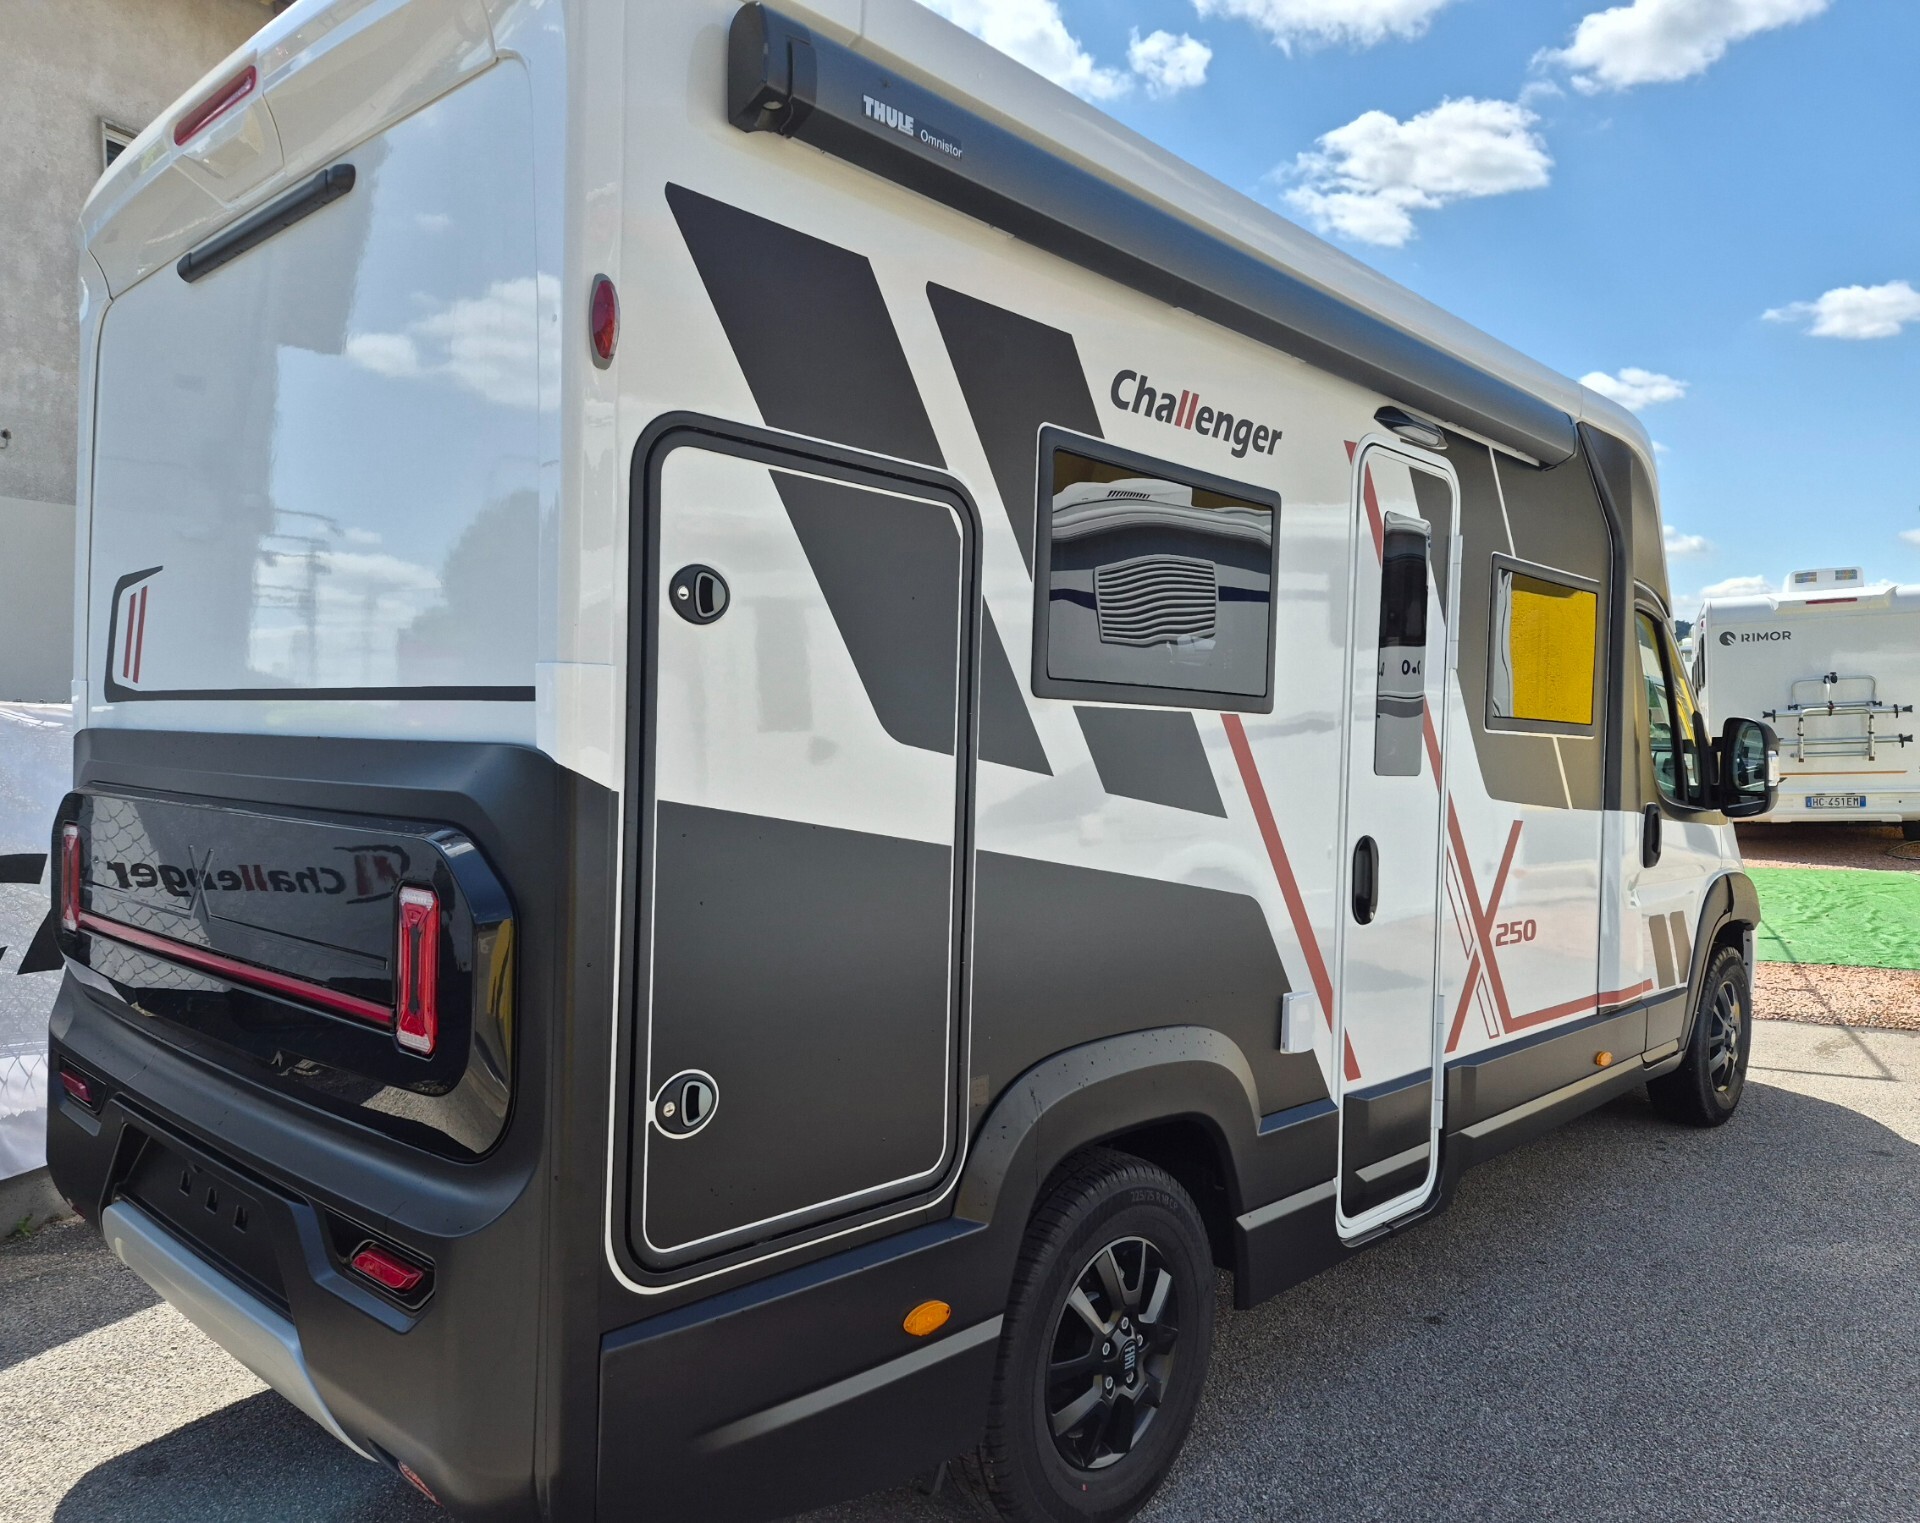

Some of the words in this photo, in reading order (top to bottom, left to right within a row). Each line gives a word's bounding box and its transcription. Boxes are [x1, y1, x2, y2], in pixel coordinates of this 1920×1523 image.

[863, 94, 914, 137] THULE
[920, 129, 963, 158] Omnistor
[1110, 369, 1283, 459] Challenger
[1741, 630, 1792, 642] RIMOR
[1495, 919, 1537, 947] 250
[1124, 1345, 1136, 1370] FIAT
